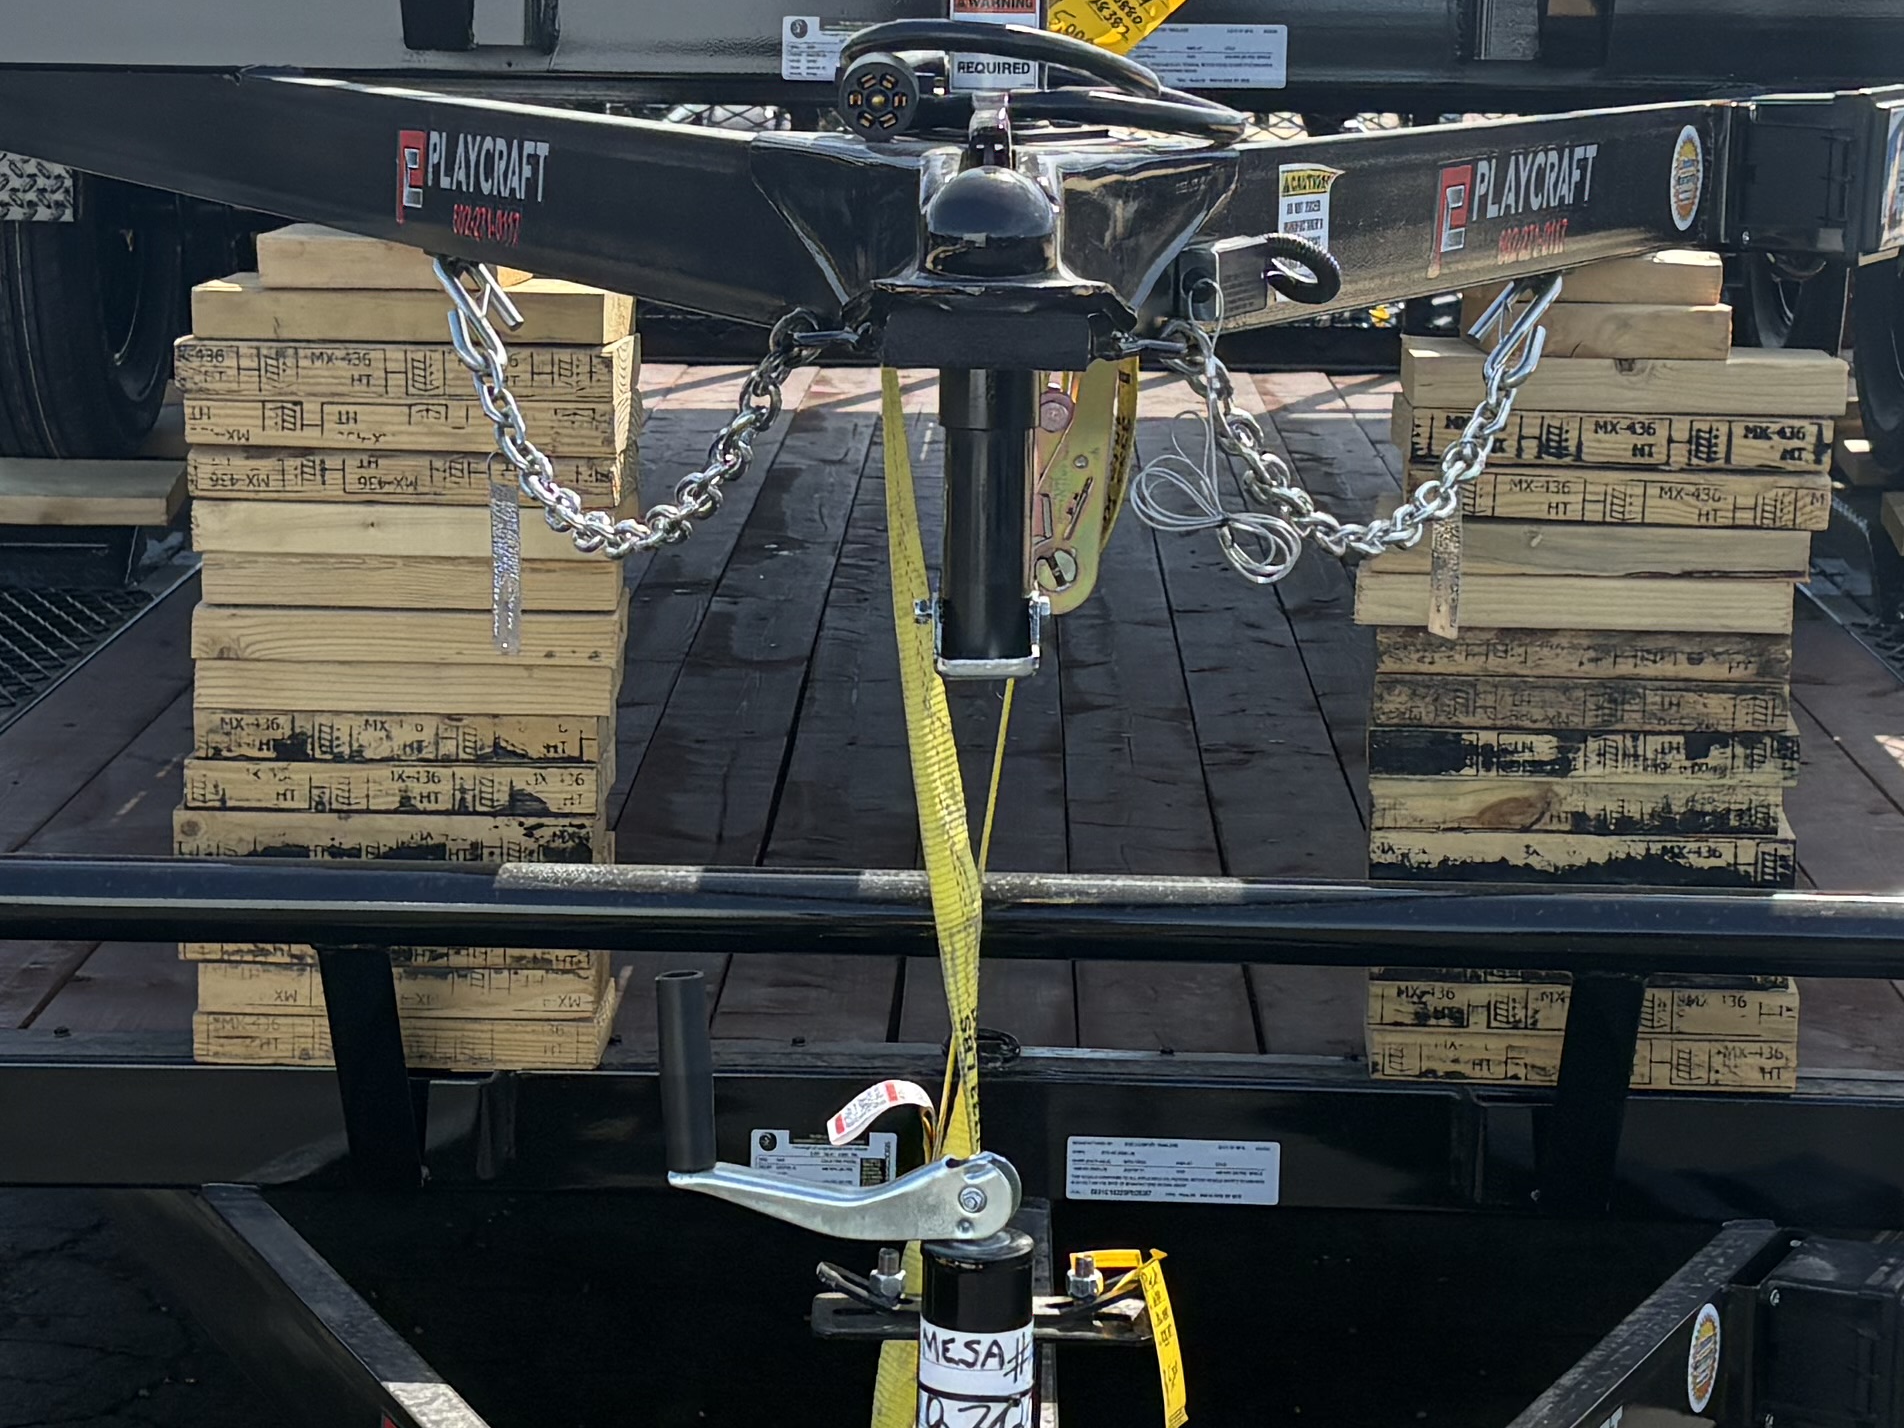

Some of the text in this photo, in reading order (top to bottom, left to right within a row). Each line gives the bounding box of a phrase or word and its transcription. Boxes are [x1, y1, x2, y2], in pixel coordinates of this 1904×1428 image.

[957, 61, 1031, 75] REQUIRED
[427, 130, 549, 202] PLAYCRAFT
[1472, 144, 1598, 221] PLAYCRAFT
[352, 373, 372, 387] HT
[1548, 502, 1569, 515] HT
[419, 791, 441, 804] HT
[923, 1327, 1005, 1370] MESA
